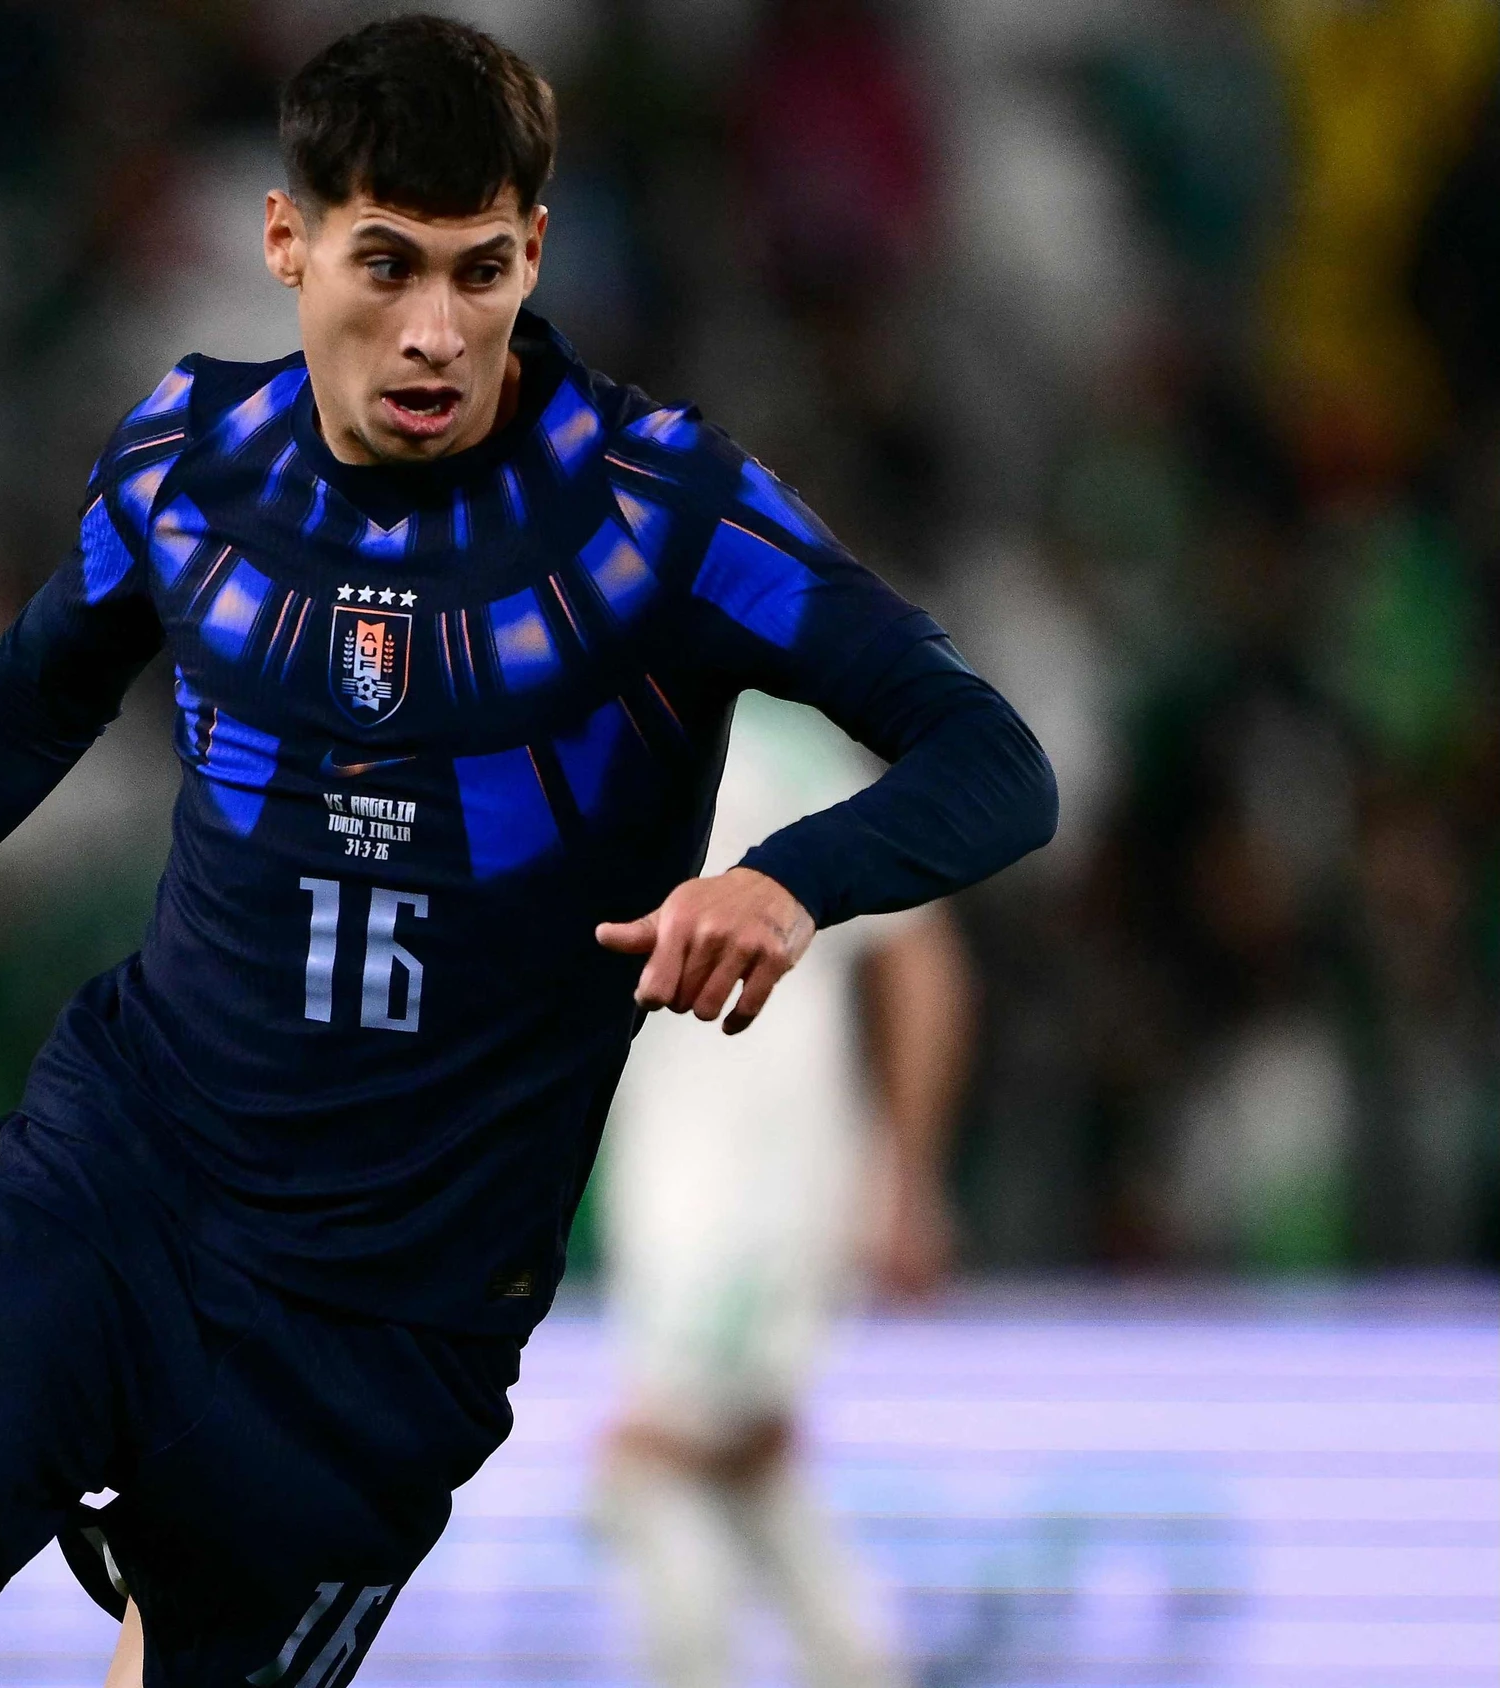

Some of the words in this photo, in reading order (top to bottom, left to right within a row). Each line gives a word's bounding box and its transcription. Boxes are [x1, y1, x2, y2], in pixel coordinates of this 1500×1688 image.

[358, 632, 378, 671] AUF
[351, 796, 416, 823] ARGELIA
[369, 821, 411, 842] ITALIA
[300, 876, 429, 1033] 16
[246, 1582, 393, 1688] 16
